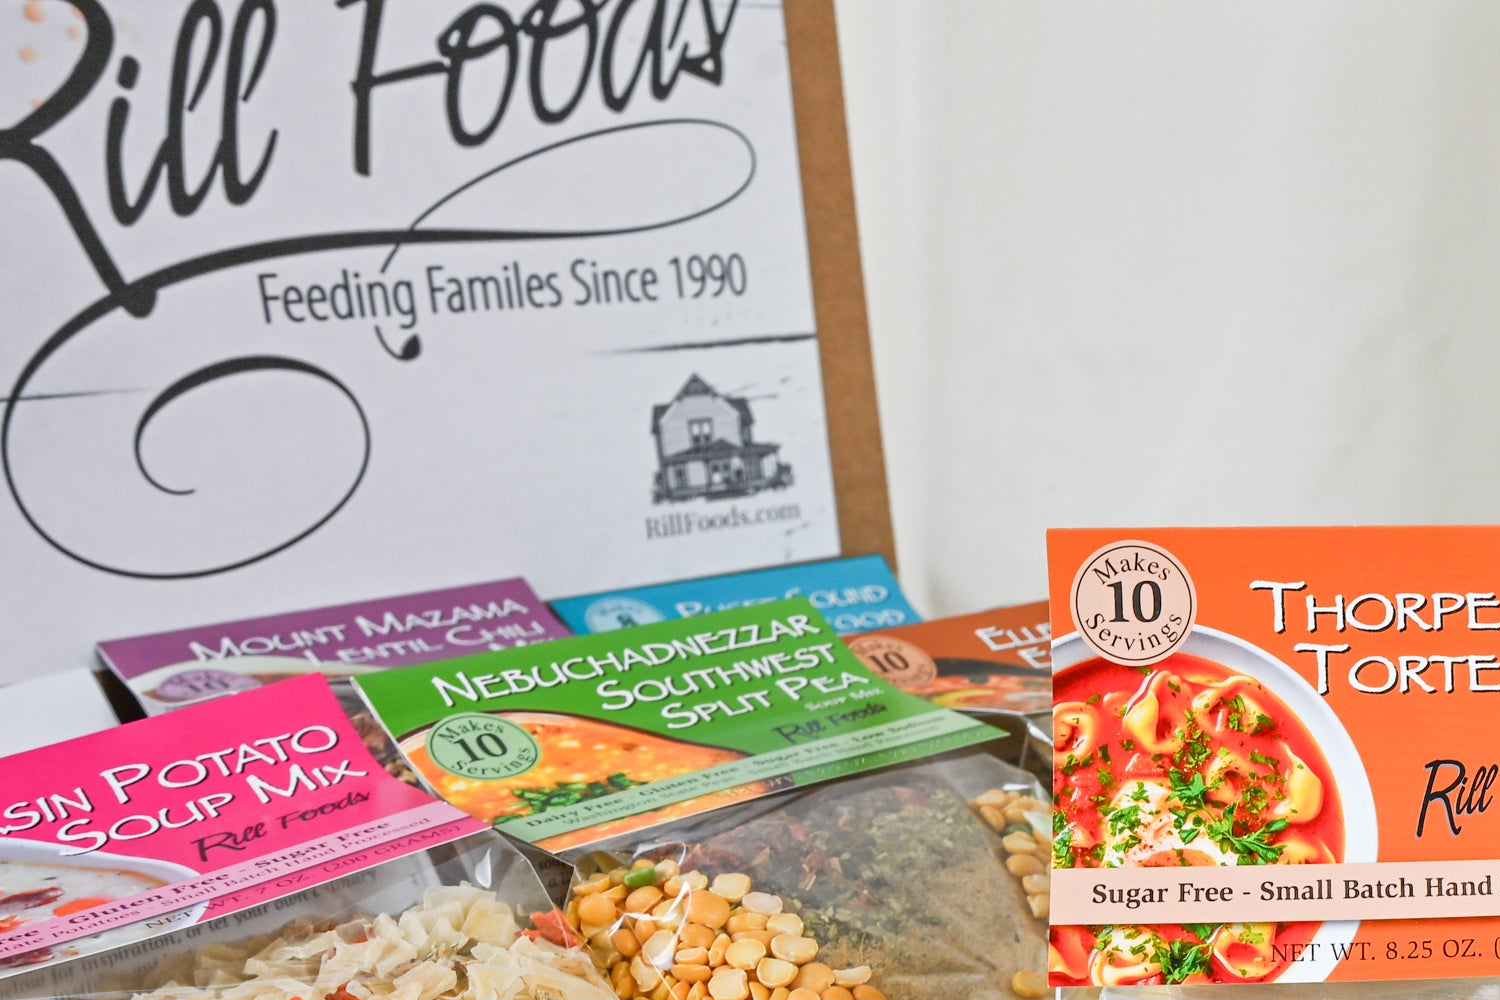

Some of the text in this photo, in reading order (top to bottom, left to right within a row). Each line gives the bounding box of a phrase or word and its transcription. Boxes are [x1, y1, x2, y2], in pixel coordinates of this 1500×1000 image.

[258, 252, 748, 330] Feeding Familes Since 1990
[645, 504, 801, 540] RillFoods.com
[1091, 550, 1173, 585] Makes
[1107, 578, 1163, 625] 10
[189, 597, 531, 664] MOUNT MAZAMA
[445, 620, 546, 647] CHILI
[1083, 609, 1183, 653] Servings
[430, 613, 821, 708] NEBUCHADNEZZAR
[597, 643, 838, 711] SOUTHWEST
[869, 650, 910, 674] 10
[661, 690, 772, 730] SPLIT
[775, 672, 870, 701] PEA
[437, 720, 504, 742] Makes
[452, 730, 508, 765] 10
[100, 725, 339, 805] POTATO
[450, 745, 532, 778] Servings
[57, 759, 369, 857] SOUP MIX
[526, 808, 579, 828] Dairy
[584, 797, 624, 814] Free
[1416, 759, 1498, 838] Rill
[191, 789, 371, 863] Rill Foods
[0, 930, 39, 946] ree
[68, 892, 163, 925] Gluten
[171, 872, 231, 895] Free
[253, 840, 327, 869] Sugar
[337, 821, 391, 842] Free
[145, 908, 195, 930] NET
[322, 854, 368, 873] (200
[373, 824, 462, 856] GRAMS)
[1092, 882, 1168, 910] Sugar
[1178, 881, 1234, 904] Free
[1259, 878, 1334, 902] Small
[1342, 876, 1415, 900] Batch
[1424, 875, 1493, 898] Hand
[1271, 942, 1320, 963] NET
[1330, 941, 1377, 962] WT.
[1386, 939, 1432, 960] 8.25
[1442, 937, 1483, 959] OZ.
